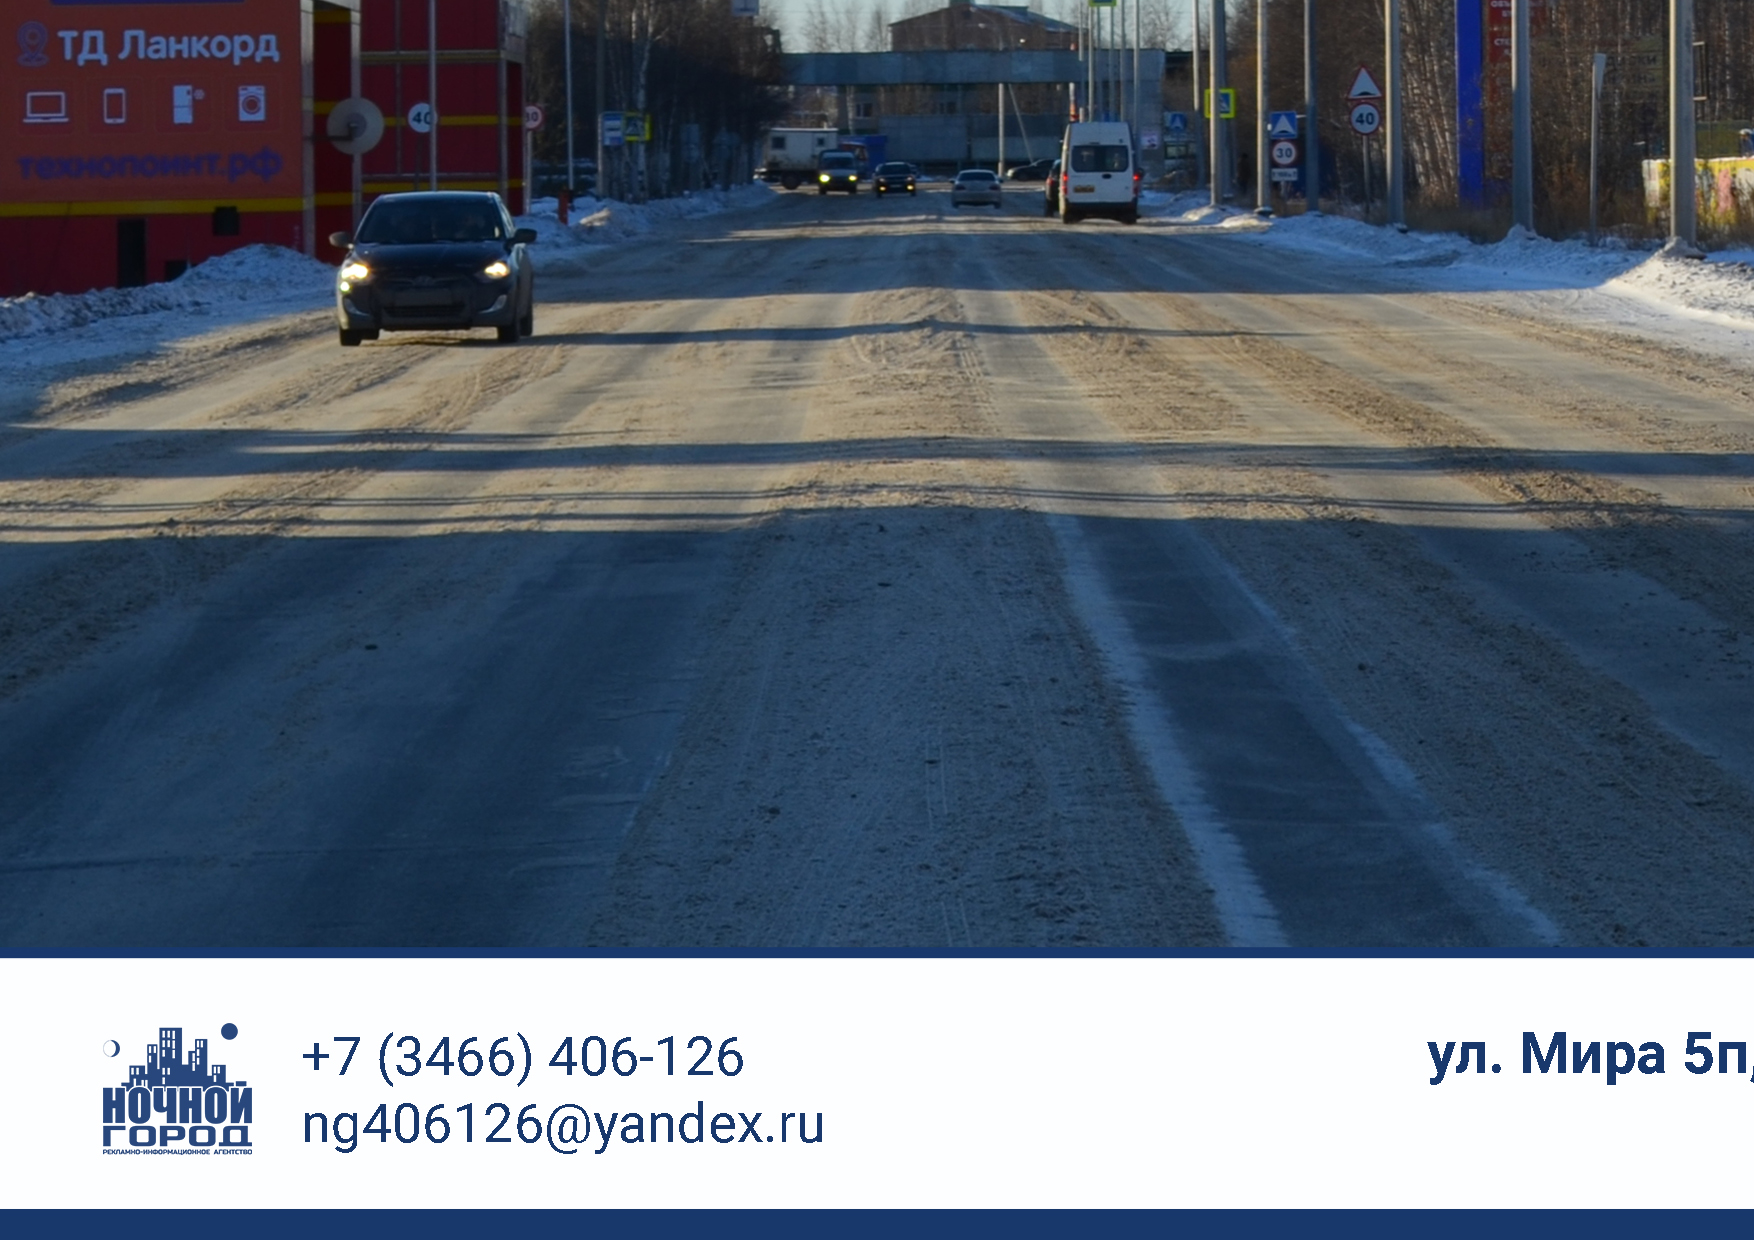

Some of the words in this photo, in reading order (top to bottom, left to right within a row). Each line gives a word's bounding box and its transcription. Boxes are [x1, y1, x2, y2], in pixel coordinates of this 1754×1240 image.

[57, 30, 108, 66] ТД
[118, 29, 280, 66] Ланкорд
[1355, 113, 1375, 125] 40
[18, 146, 282, 183] технопоинт.рф
[1276, 148, 1293, 158] 30
